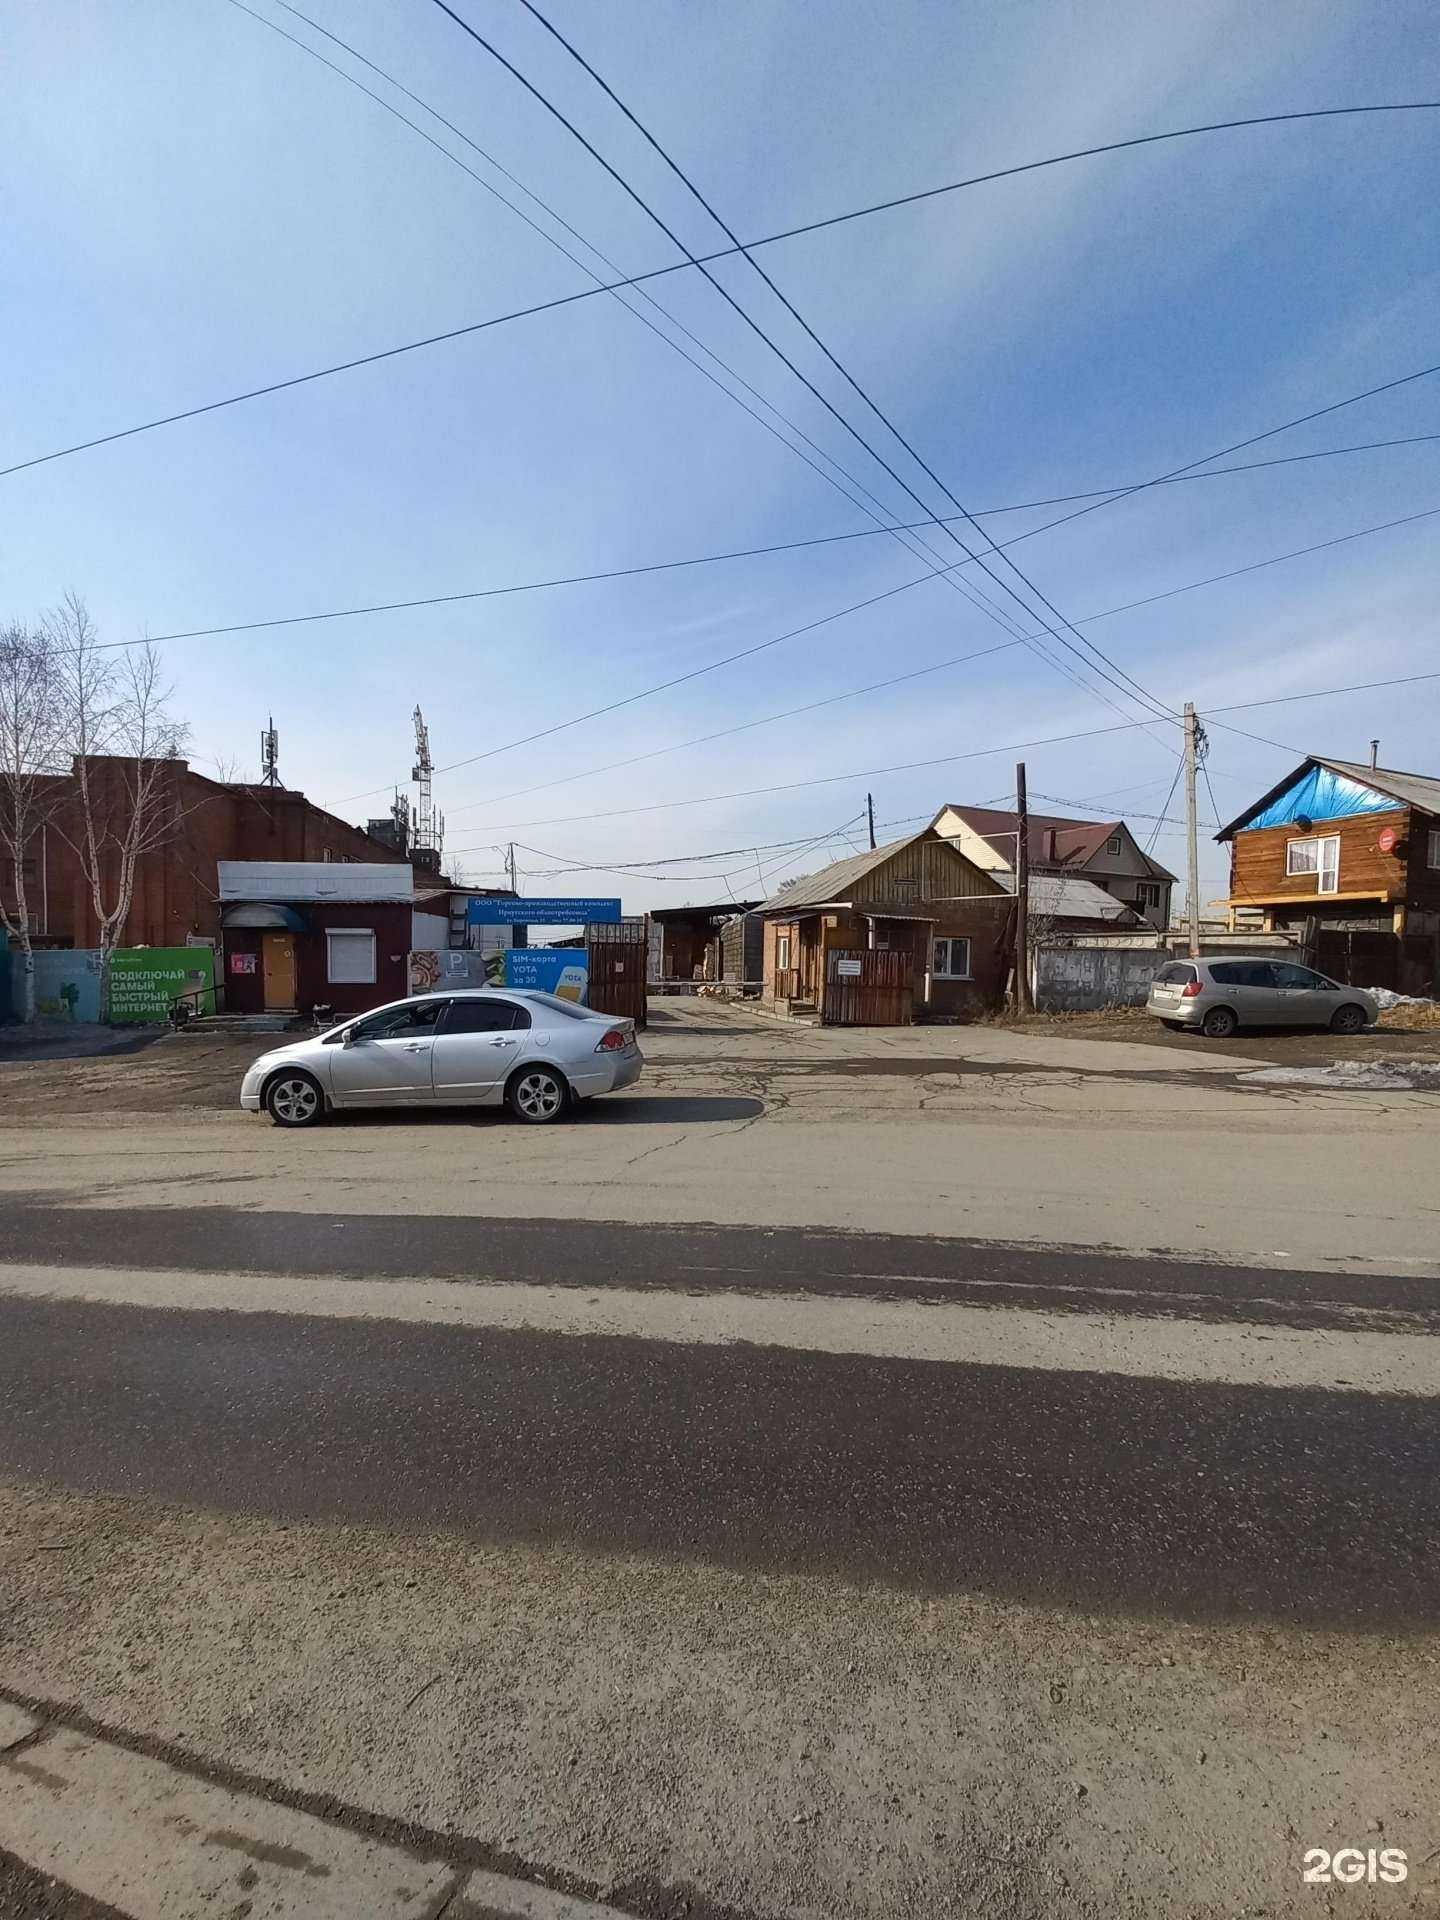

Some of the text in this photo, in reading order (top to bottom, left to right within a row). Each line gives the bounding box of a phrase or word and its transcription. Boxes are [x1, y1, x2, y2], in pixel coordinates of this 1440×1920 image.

[111, 969, 185, 980] ПОДКЛЮЧАЙ
[513, 966, 537, 974] YOTA
[111, 981, 156, 991] САМЫЙ
[112, 991, 169, 1002] БЫСТРЫЙ
[112, 1003, 168, 1013] ИНТЕРНЕТ
